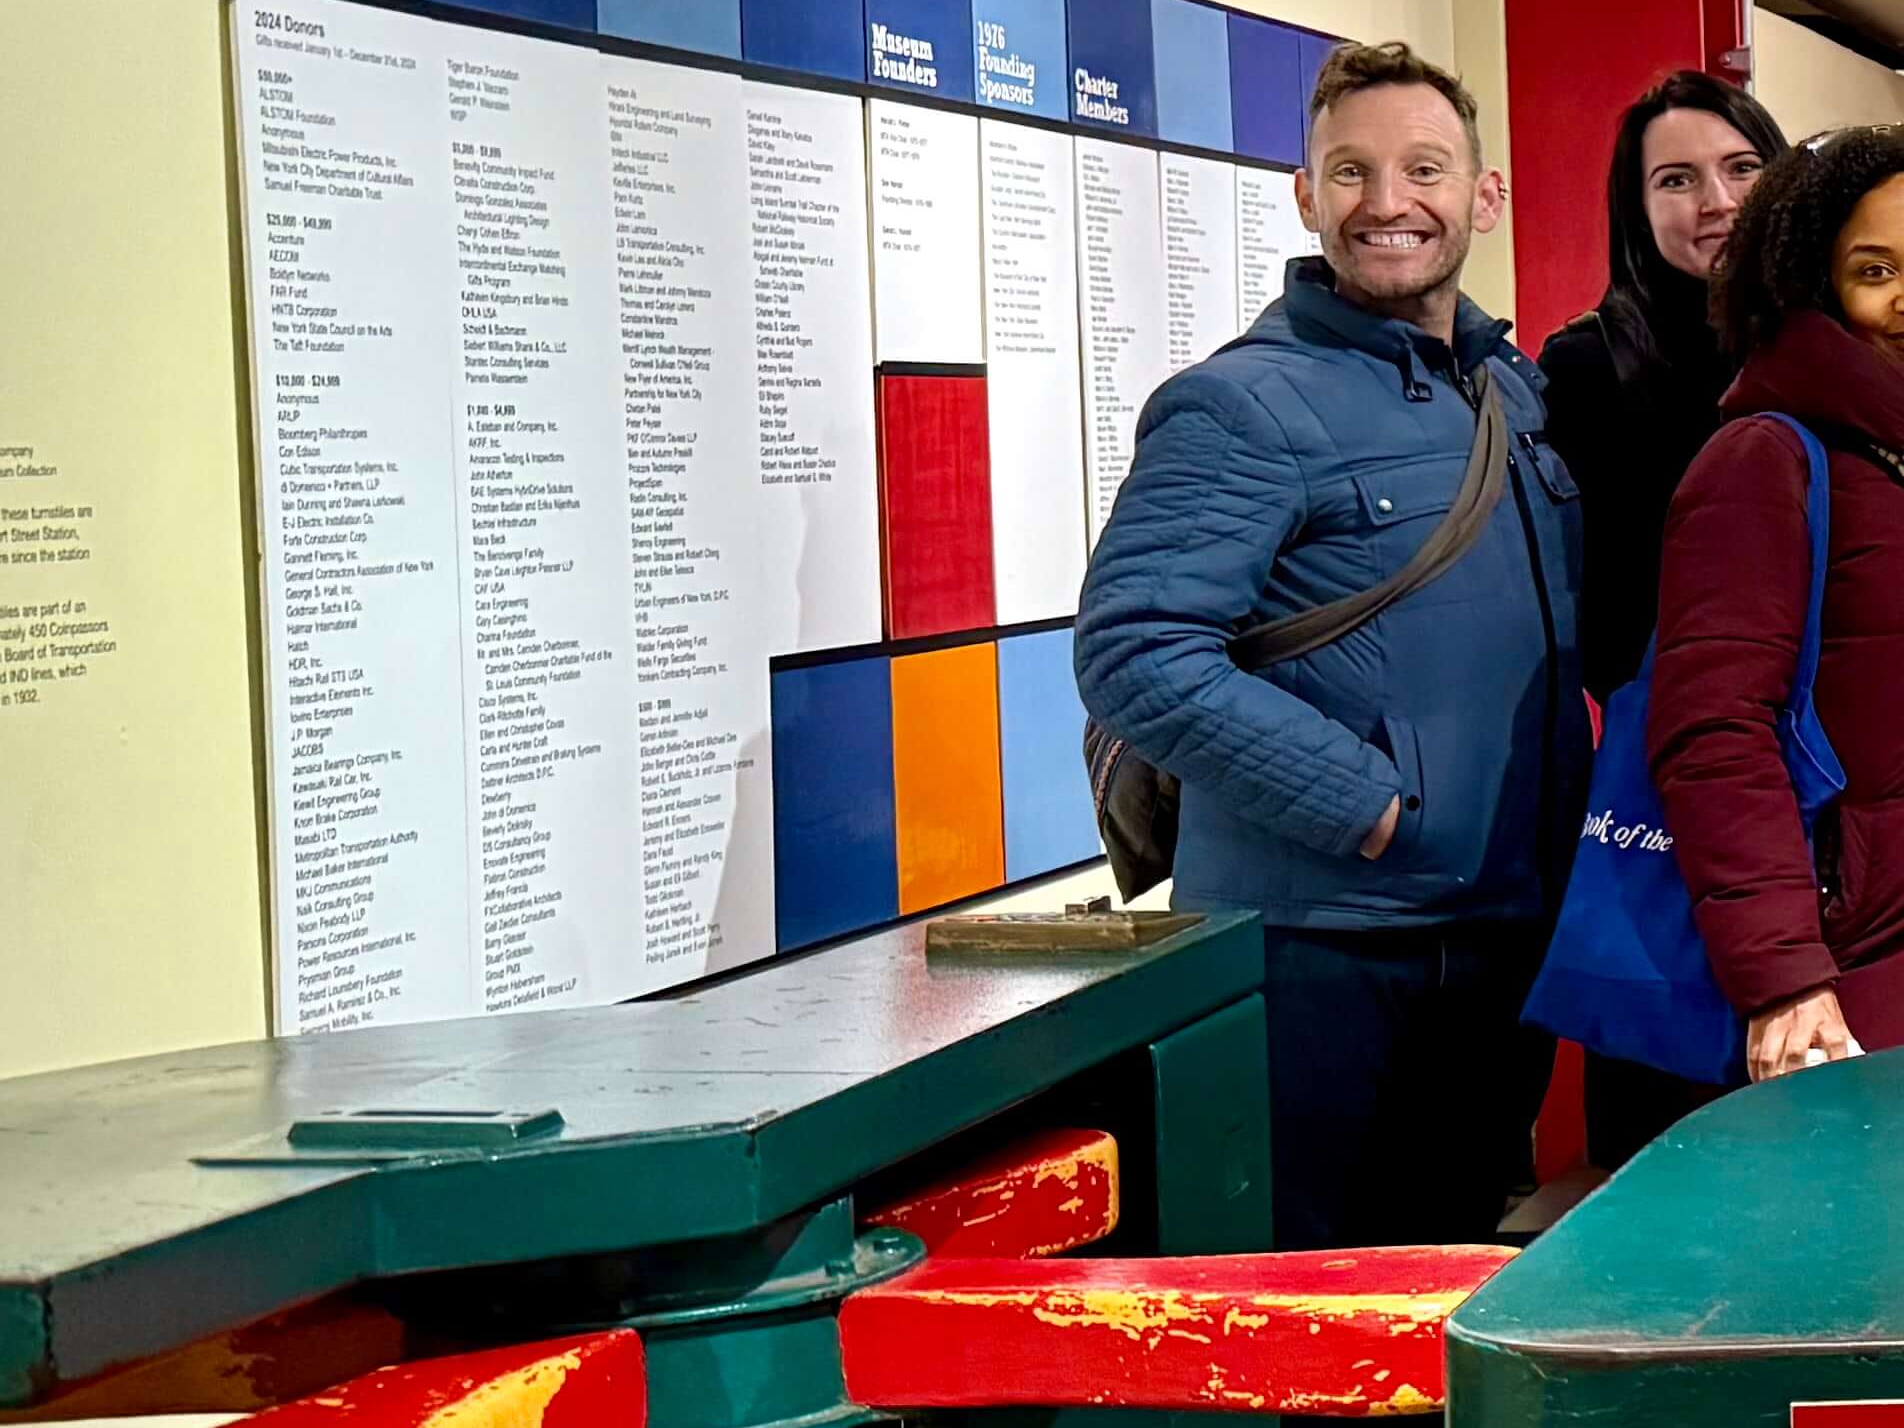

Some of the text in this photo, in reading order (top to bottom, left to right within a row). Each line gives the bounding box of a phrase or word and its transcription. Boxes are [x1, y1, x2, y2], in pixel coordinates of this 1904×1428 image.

[254, 10, 325, 38] 2024 Donors
[978, 21, 1005, 49] 1976
[871, 23, 933, 61] Museum
[873, 51, 937, 87] Founders
[979, 47, 1035, 86] Founding
[980, 73, 1034, 106] Sponsors
[1075, 68, 1119, 99] Charter
[1075, 92, 1129, 125] Members
[17, 464, 57, 476] Collection
[32, 505, 75, 519] turnstiles
[78, 507, 92, 518] are
[11, 526, 80, 542] Street Station,
[11, 548, 90, 564] since the station
[22, 600, 86, 619] are part of an
[29, 621, 108, 637] 450 Coinpassors
[4, 640, 116, 662] Board of Transportation
[10, 664, 87, 682] IND lines, which
[2, 688, 40, 705] in 1932.
[1614, 823, 1646, 849] of
[1640, 829, 1673, 852] the
